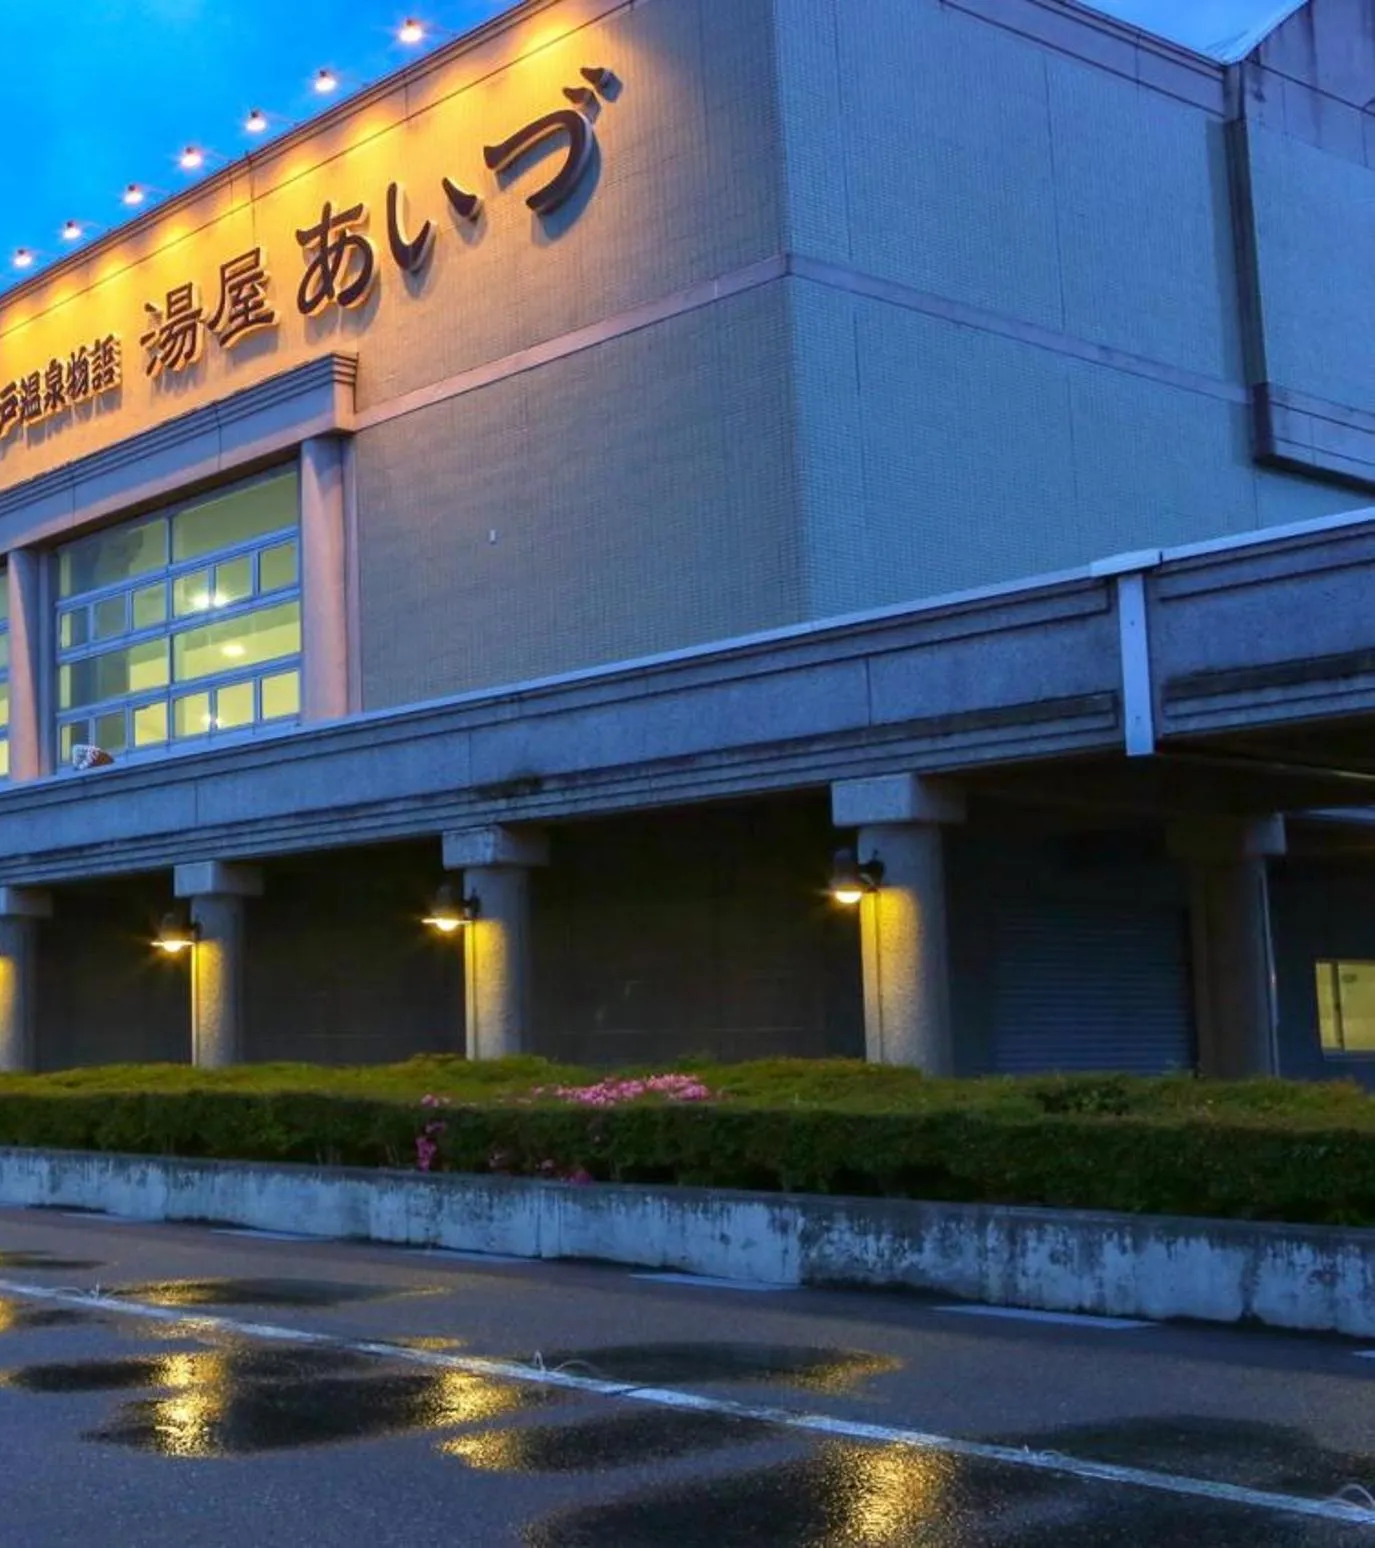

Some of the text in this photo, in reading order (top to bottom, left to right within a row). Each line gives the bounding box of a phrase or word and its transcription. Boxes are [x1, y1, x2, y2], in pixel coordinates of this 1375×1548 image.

[140, 247, 276, 378] 湯屋
[296, 67, 617, 314] あいづ
